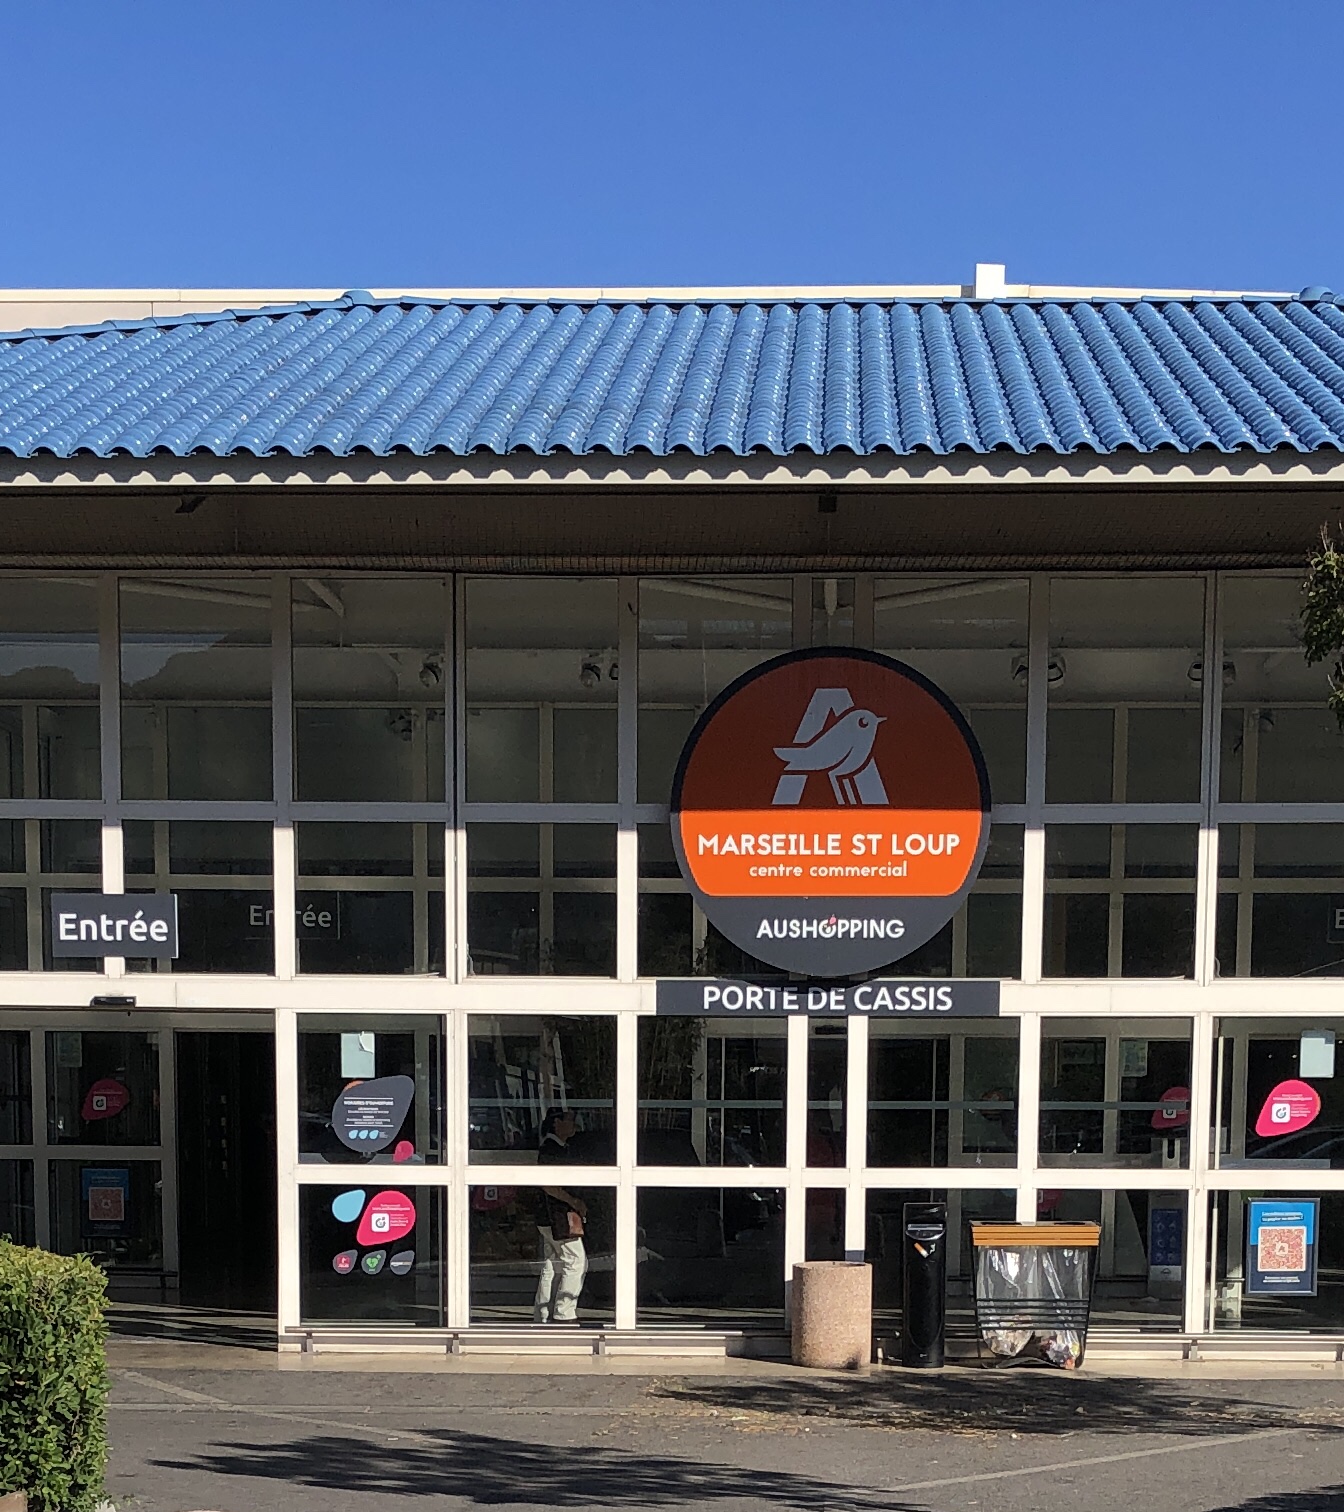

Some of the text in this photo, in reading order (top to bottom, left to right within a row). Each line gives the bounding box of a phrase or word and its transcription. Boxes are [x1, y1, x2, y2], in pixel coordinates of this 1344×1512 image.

[698, 833, 961, 856] MARSEILLE ST LOUP
[749, 860, 908, 877] centre commercial
[58, 909, 169, 942] Entrée
[249, 903, 333, 928] Enée
[756, 915, 906, 939] AUSHOPPING
[703, 985, 953, 1011] PORTE DE CASSIS
